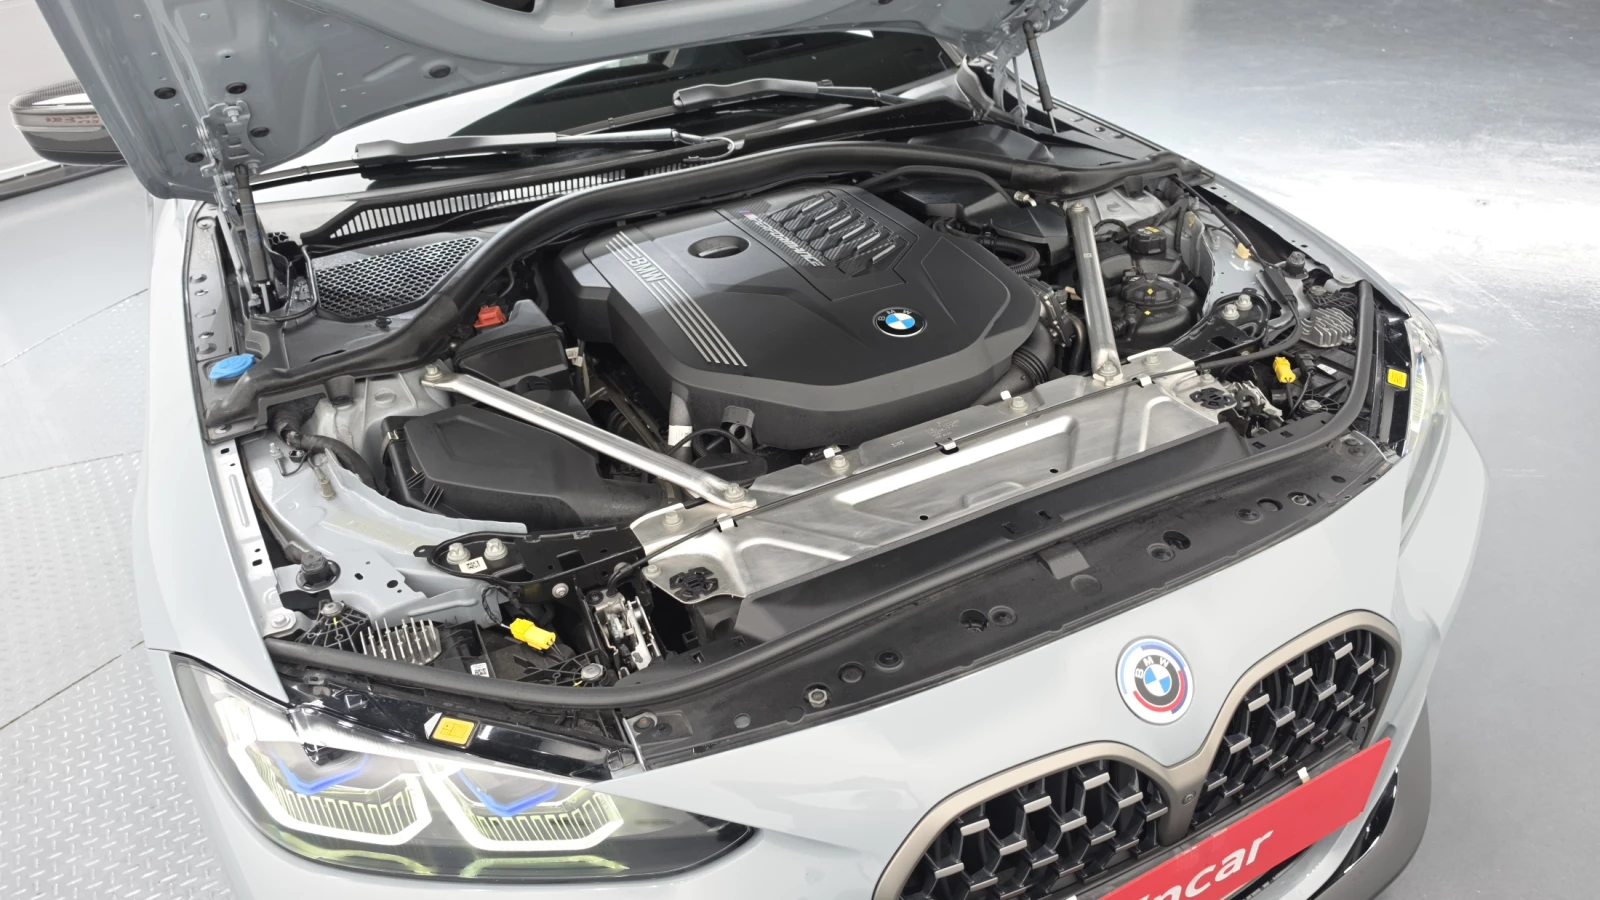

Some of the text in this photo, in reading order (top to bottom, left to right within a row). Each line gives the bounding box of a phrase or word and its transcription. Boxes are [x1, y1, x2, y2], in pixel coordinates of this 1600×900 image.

[628, 256, 666, 282] BMW
[877, 309, 912, 321] BMW
[1134, 655, 1170, 679] BMW
[1139, 830, 1274, 900] ncar
